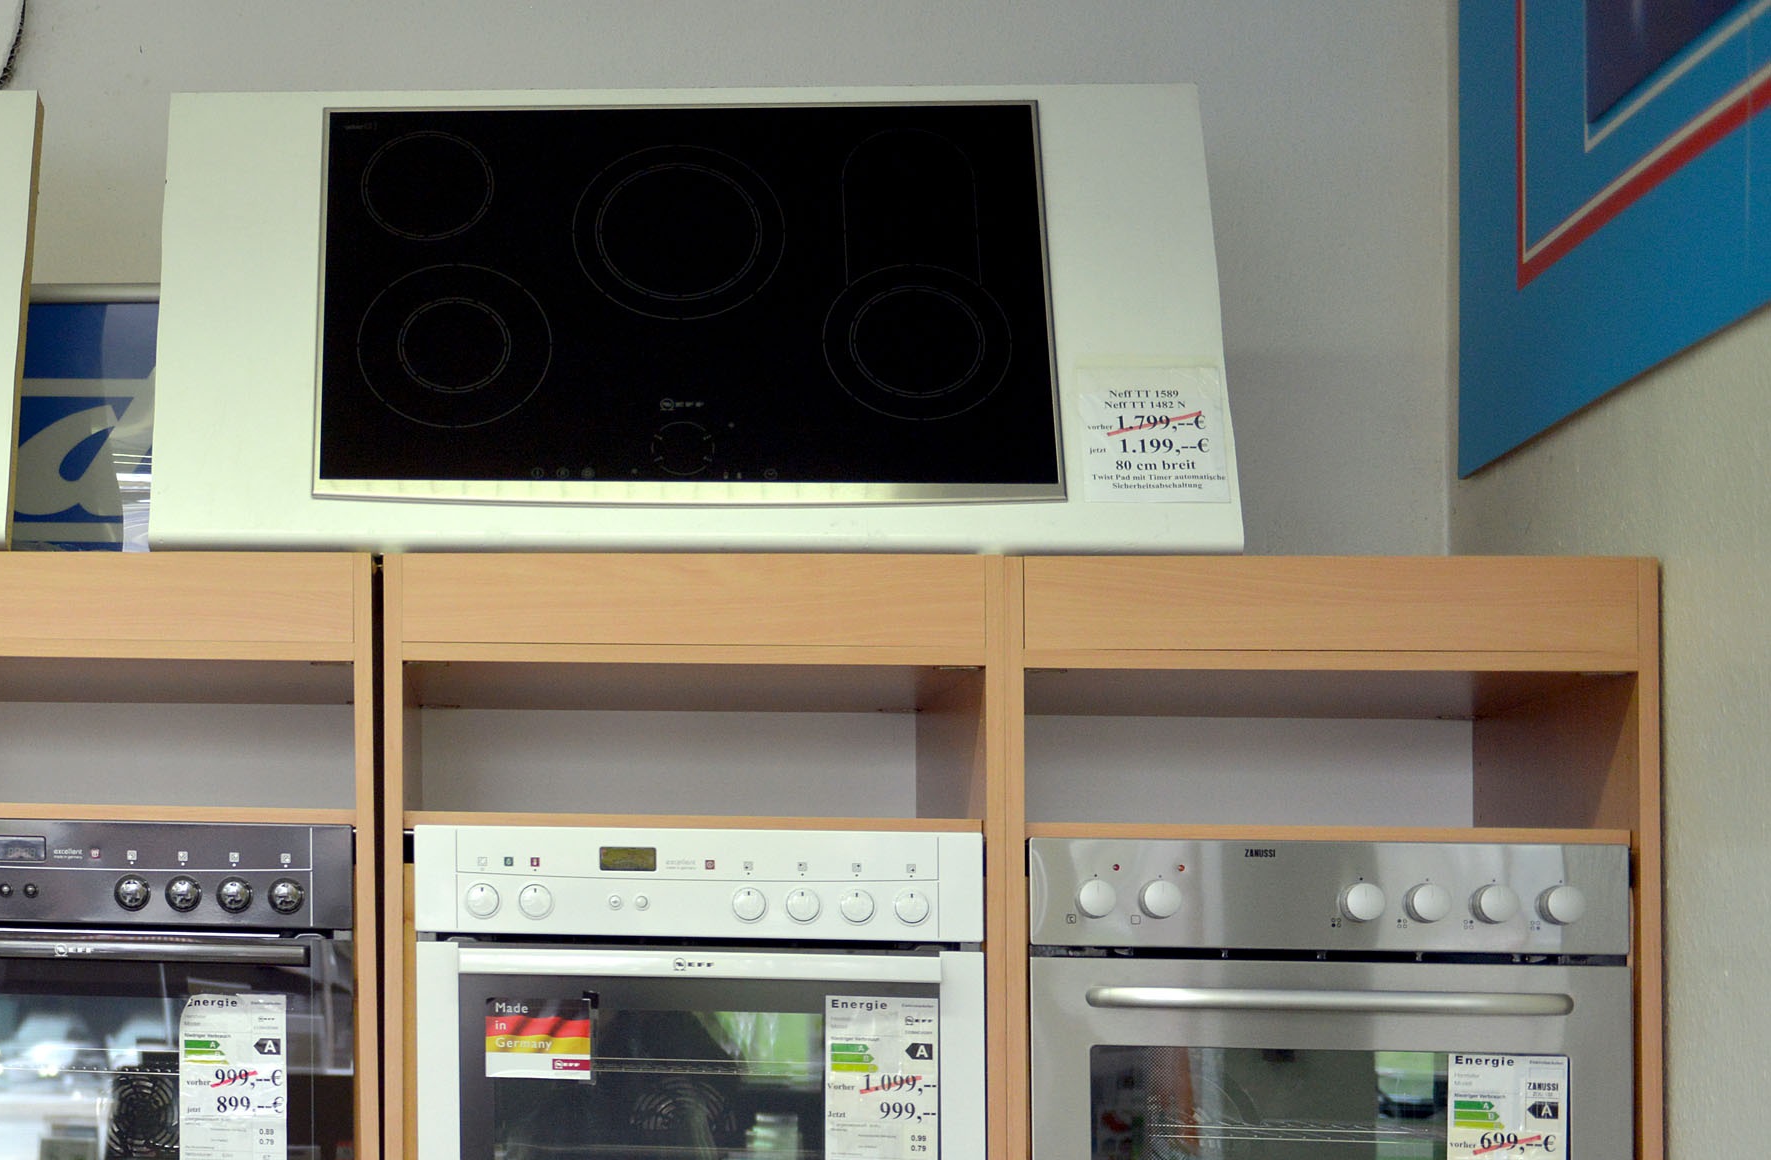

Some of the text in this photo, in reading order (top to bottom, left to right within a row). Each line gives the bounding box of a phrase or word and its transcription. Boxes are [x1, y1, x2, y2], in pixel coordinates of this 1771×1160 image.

[1109, 389, 1133, 399] Neff
[1155, 390, 1179, 398] 1589
[1104, 400, 1127, 409] Neff
[1087, 423, 1113, 431] vorher
[1089, 438, 1210, 456] jetzt 1.199,--€
[1115, 459, 1197, 471] 80 cm breit
[1244, 848, 1276, 858] ZANUSSI
[495, 1002, 528, 1014] Made
[831, 1000, 888, 1011] Energie
[495, 1020, 506, 1030] in
[264, 1040, 276, 1052] A
[495, 1038, 552, 1052] Germany
[916, 1045, 928, 1058] A
[1455, 1056, 1514, 1068] Energie
[186, 1069, 283, 1088] vorher 999,--€
[827, 1074, 936, 1096] Vorher 1.099,--
[1528, 1082, 1558, 1092] ZANUSSI
[827, 1102, 936, 1123] Jetzt 999,--
[1541, 1102, 1552, 1116] A
[910, 1134, 926, 1142] 0.99
[1450, 1132, 1556, 1154] vorher 699,--€
